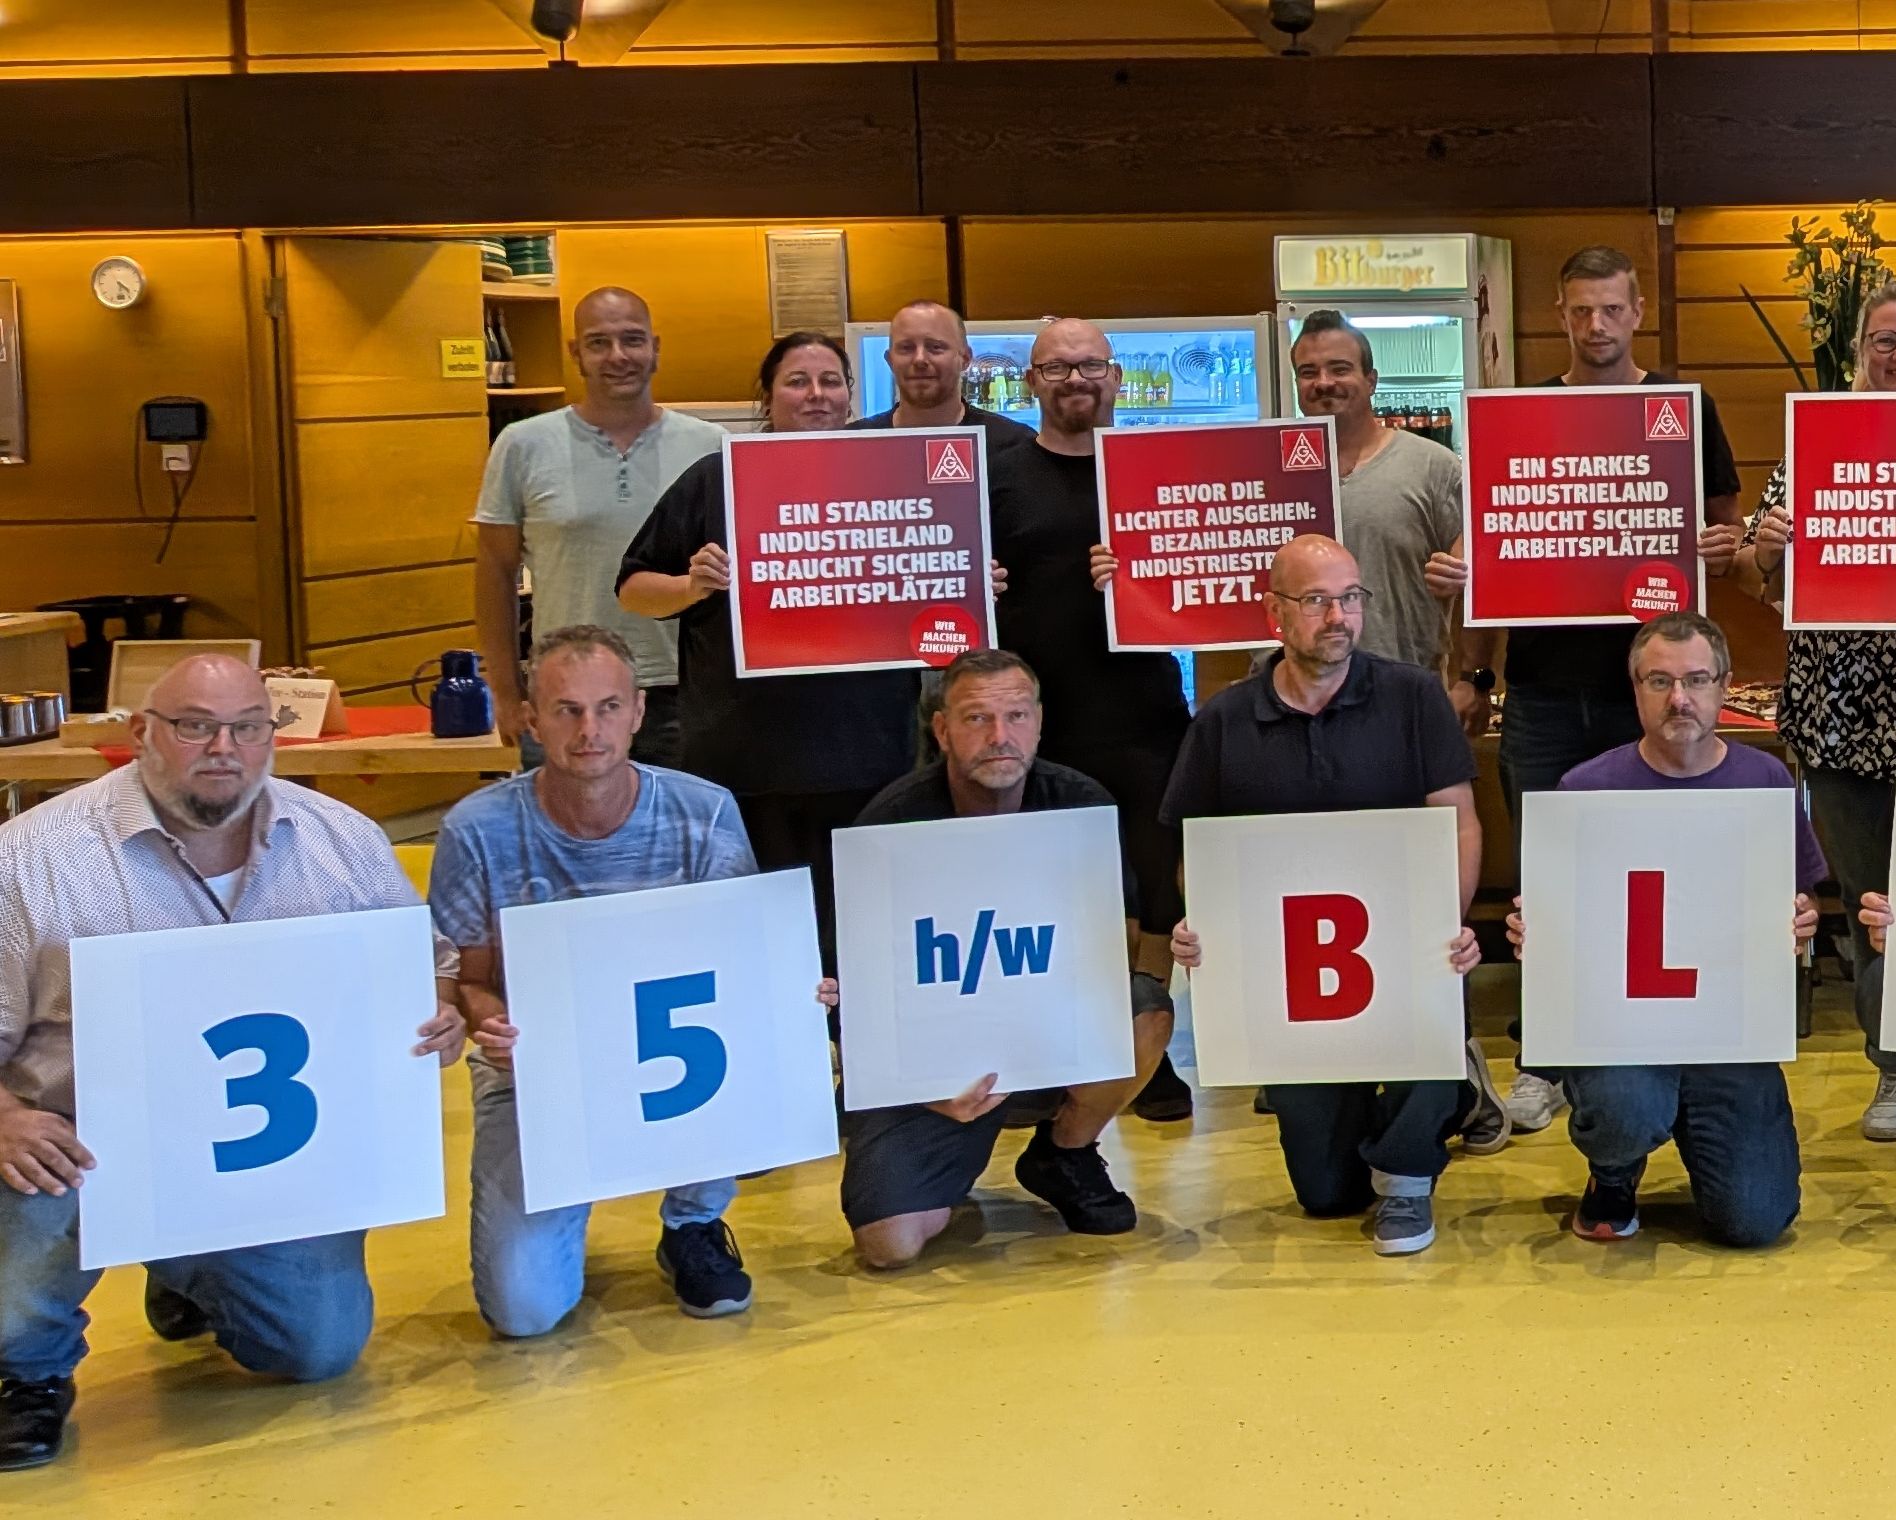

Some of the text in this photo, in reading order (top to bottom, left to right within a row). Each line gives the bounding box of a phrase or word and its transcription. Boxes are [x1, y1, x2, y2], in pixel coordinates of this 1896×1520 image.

[1314, 245, 1434, 292] Bitburger
[1510, 455, 1650, 478] EIN STARKES
[1834, 463, 1870, 483] EIN
[1157, 480, 1265, 505] BEVOR DIE
[1492, 482, 1668, 506] INDUSTRIELAND
[780, 498, 933, 525] EIN STARKES
[1115, 502, 1316, 531] LICHTER AUSGEHEN:
[1484, 508, 1684, 532] BRAUCHT SICHERE
[760, 525, 953, 554] INDUSTRIELAND
[1151, 527, 1294, 553] BEZAHLBARER
[1499, 531, 1678, 559] ARBEITSPLÄTZE!
[752, 550, 970, 582] BRAUCHT SICHERE
[770, 575, 966, 608] ARBEITSPLÄTZE!
[1172, 575, 1262, 612] JETZT.
[1636, 588, 1676, 600] MACHEN
[1648, 577, 1667, 587] WIR
[1632, 599, 1678, 611] ZUKUNFT!
[923, 632, 966, 643] MACHEN
[935, 621, 955, 631] WIR
[202, 1013, 317, 1172] 3
[634, 971, 726, 1122] 5
[915, 910, 1055, 995] h/w
[1283, 894, 1374, 1021] B
[1628, 872, 1697, 997] L
